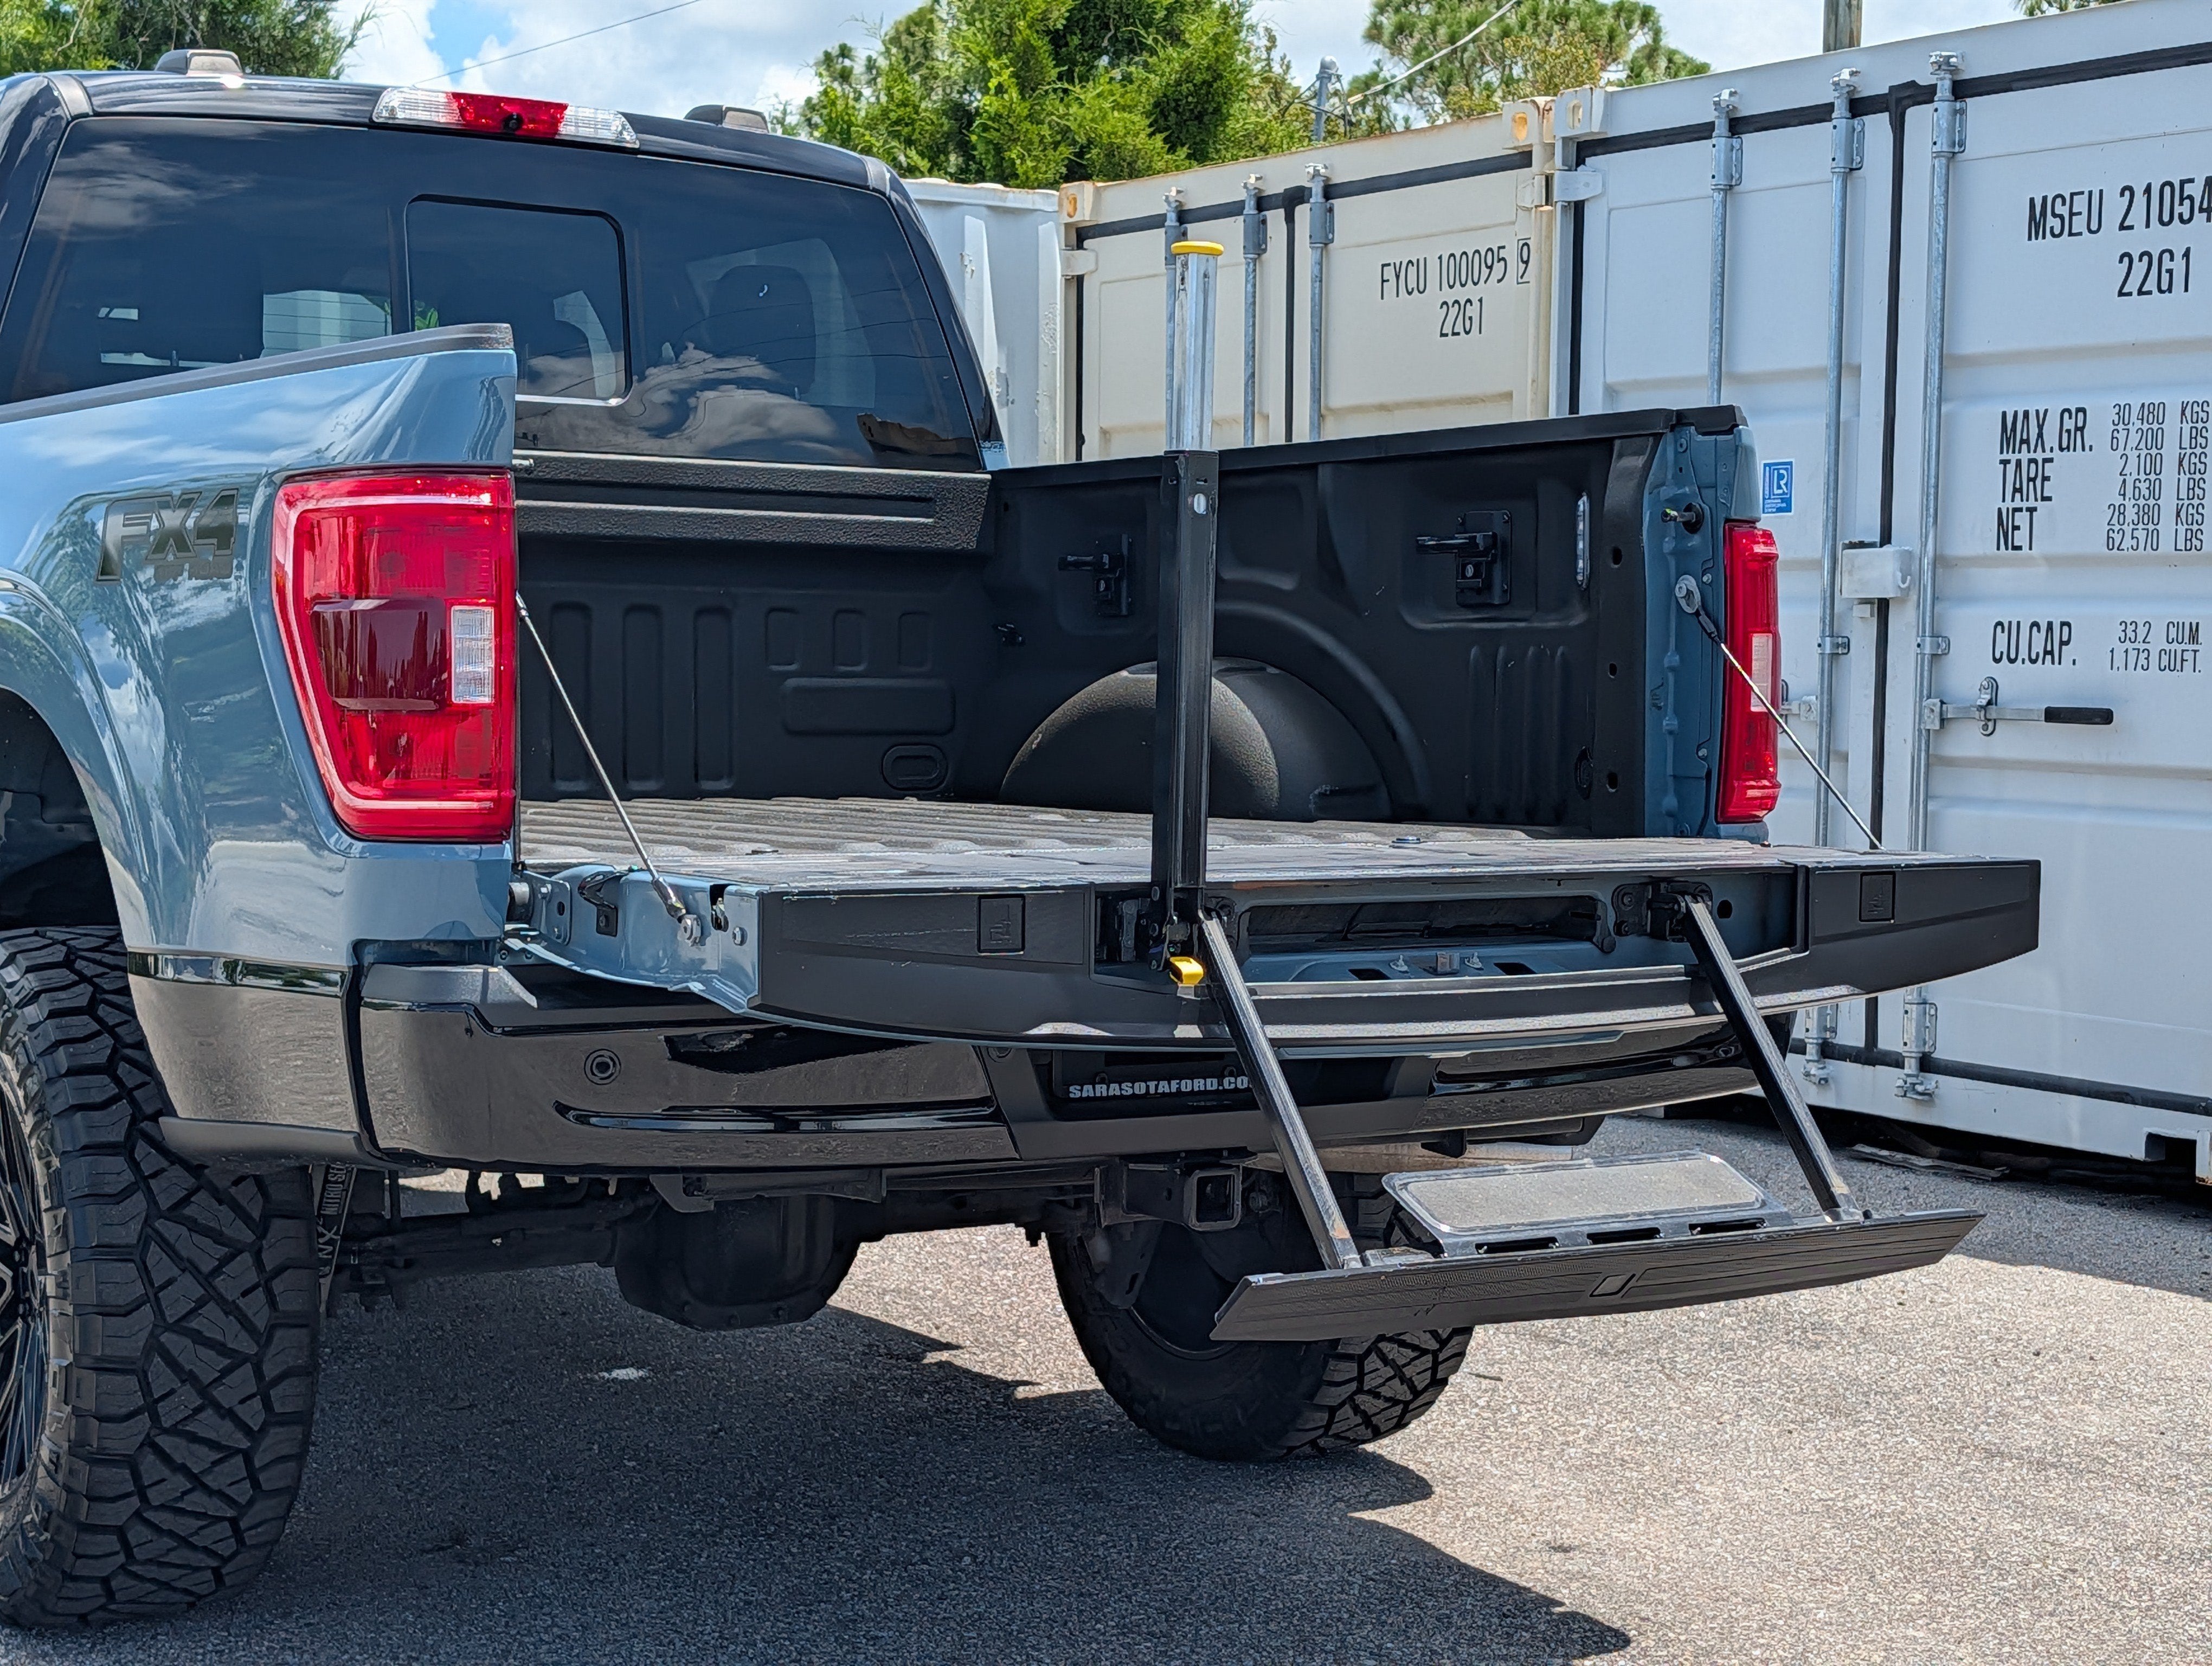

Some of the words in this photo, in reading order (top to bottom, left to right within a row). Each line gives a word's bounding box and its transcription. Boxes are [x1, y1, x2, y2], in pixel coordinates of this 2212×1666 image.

[2027, 189, 2104, 241] MSEU
[2118, 175, 2212, 232] 21054
[1380, 257, 1427, 300] FYCU
[1437, 245, 1508, 292] 100095
[1519, 241, 1531, 280] 9
[2117, 246, 2191, 298] 22G1
[1439, 296, 1483, 338] 22G1
[2112, 401, 2166, 427] 30,480
[2180, 400, 2210, 425] KGS
[1999, 407, 2093, 455] MAX.GR.
[2111, 427, 2164, 452] 67,200
[2179, 426, 2209, 450] LBS
[1999, 457, 2054, 503] TARE
[2119, 452, 2163, 477] 2,100
[2178, 451, 2208, 476] KGS
[2118, 478, 2162, 502] 4,630
[2176, 477, 2206, 501] LBS
[1996, 507, 2038, 551] NET
[2107, 502, 2161, 527] 28,380
[2175, 502, 2205, 527] KGS
[96, 487, 239, 582] FX4
[2106, 527, 2159, 552] 62,570
[2174, 528, 2203, 552] LBS
[1992, 620, 2076, 666] CU.CAP.
[2118, 620, 2152, 644] 33.2
[2110, 647, 2150, 672] 1,173
[1069, 1075, 1251, 1099] SARASOTAFORD.CO
